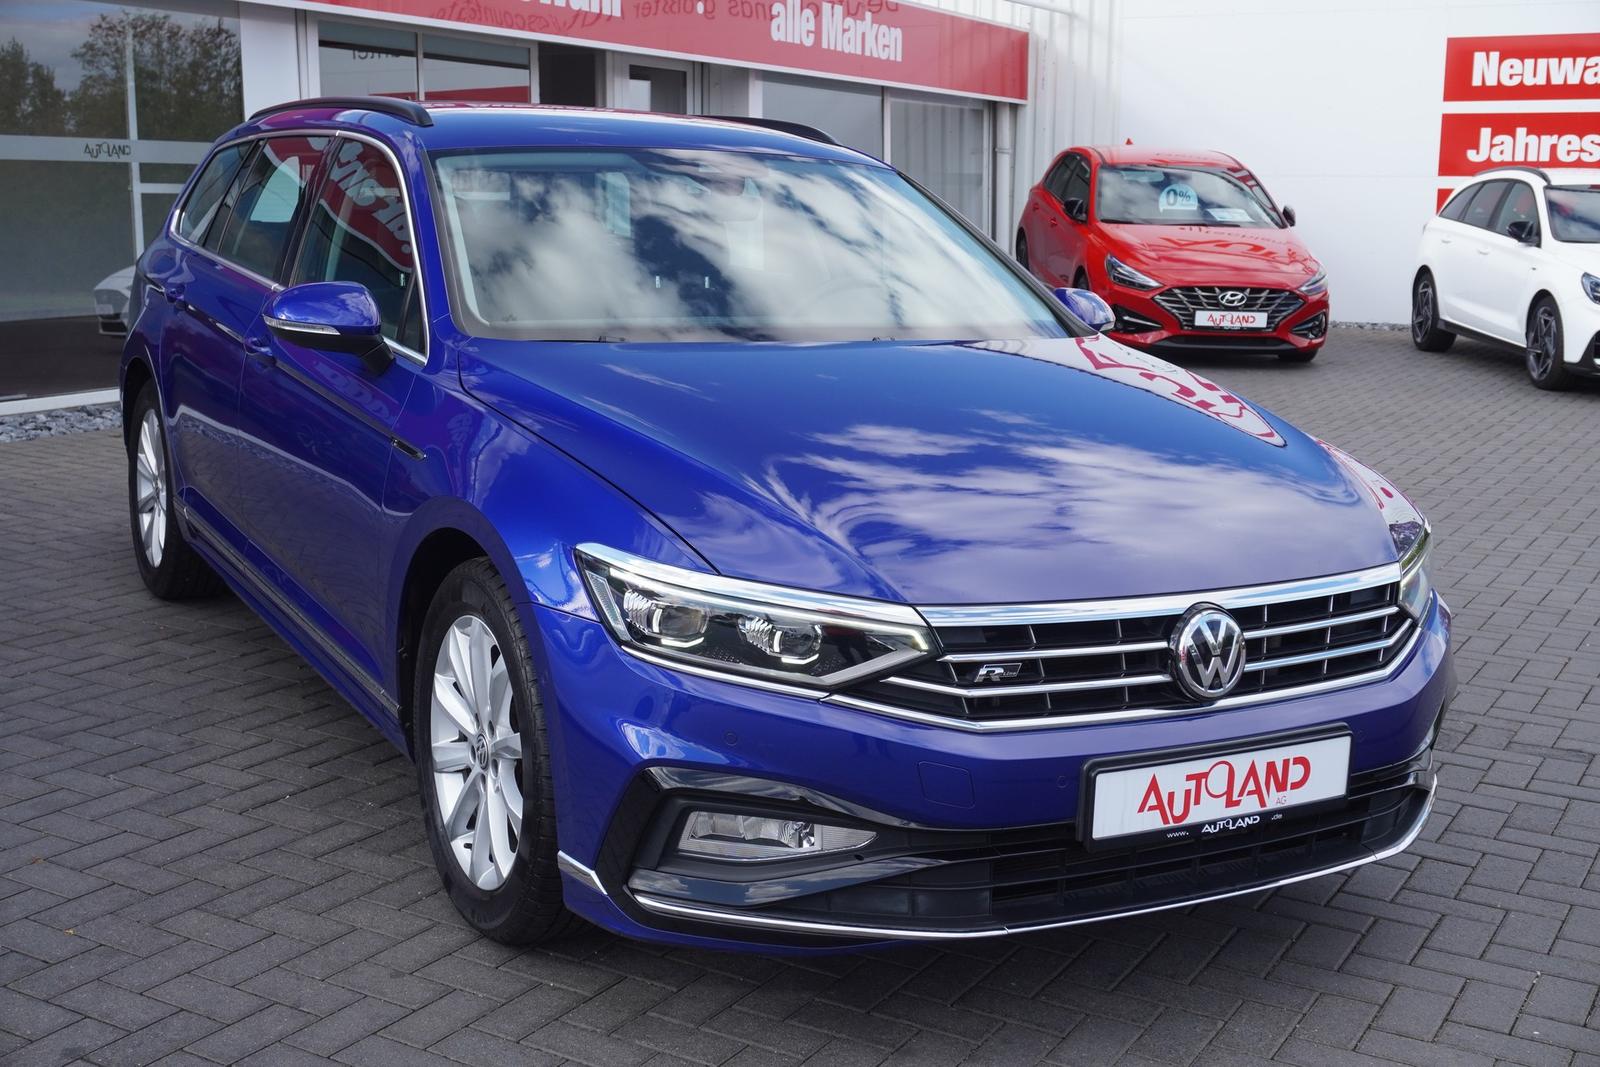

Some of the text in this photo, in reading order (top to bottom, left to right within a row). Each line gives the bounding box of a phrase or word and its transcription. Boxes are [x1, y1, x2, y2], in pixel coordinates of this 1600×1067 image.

[770, 0, 903, 62] alle Marken
[1471, 51, 1600, 87] Neuwa
[1466, 127, 1600, 163] Jahres
[1166, 188, 1191, 206] 0%
[1275, 795, 1287, 806] AG
